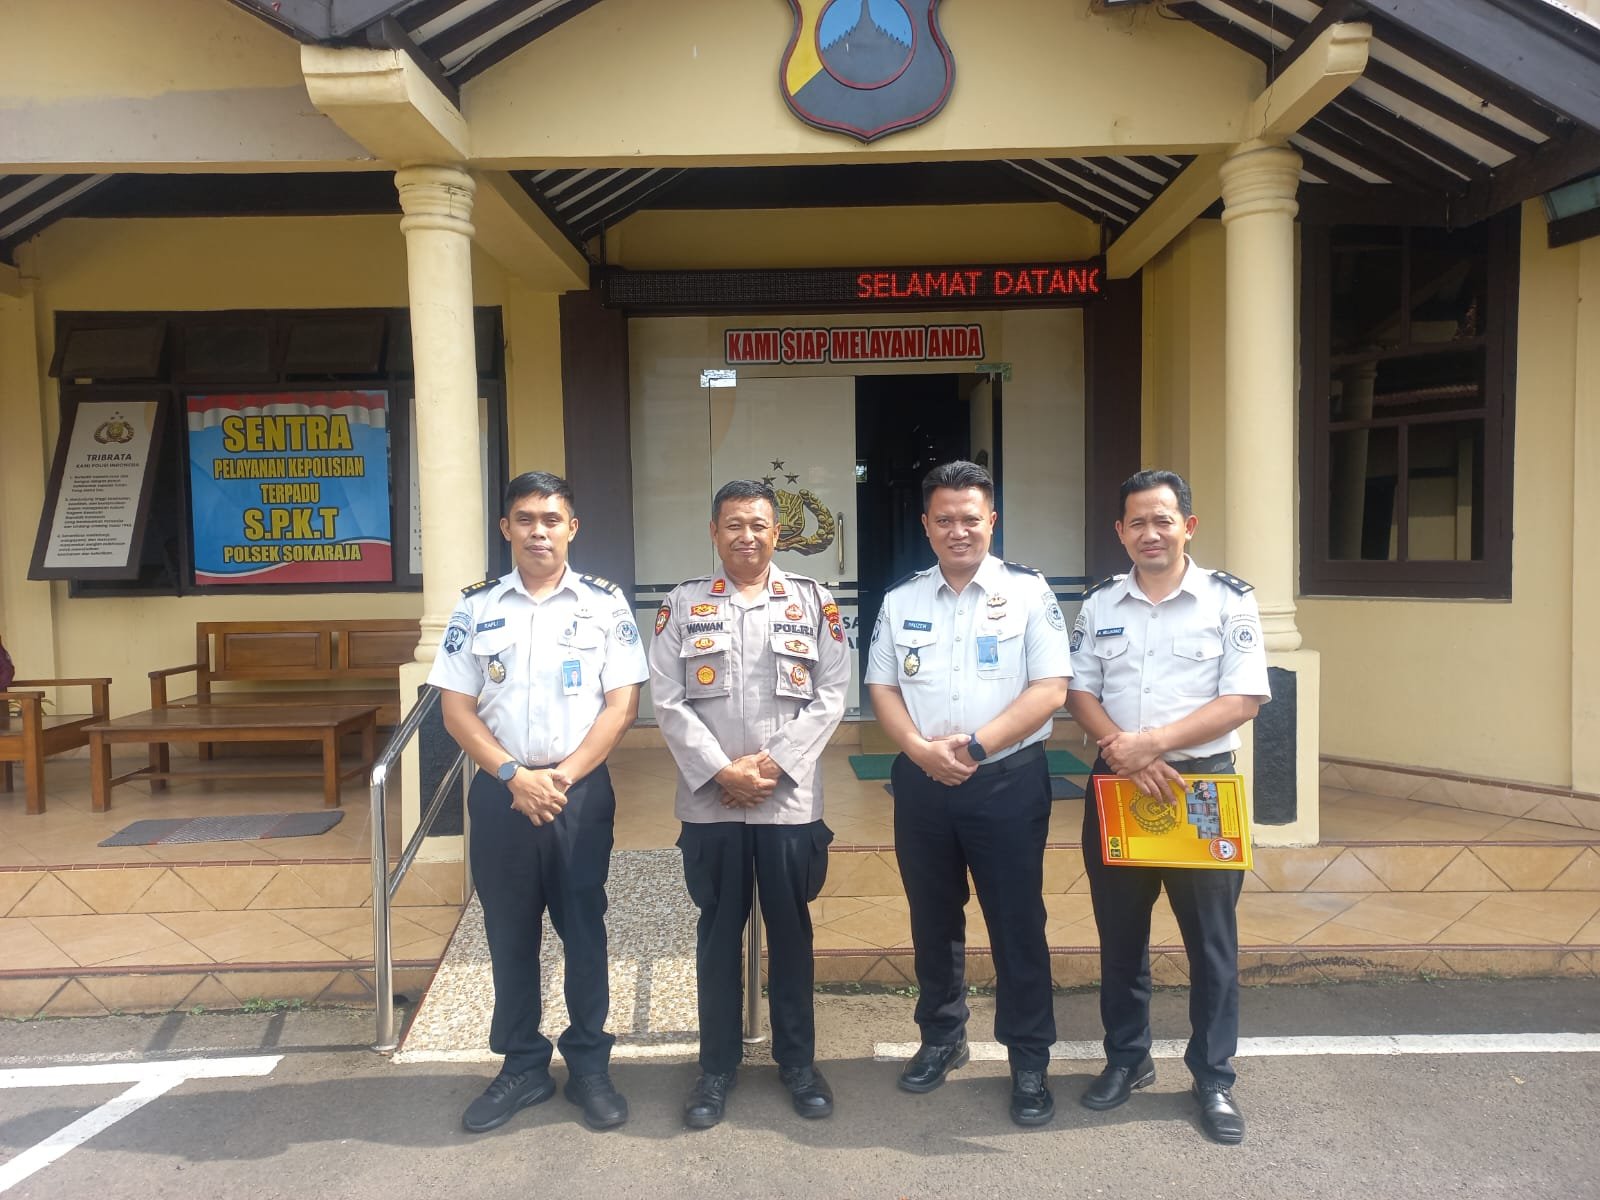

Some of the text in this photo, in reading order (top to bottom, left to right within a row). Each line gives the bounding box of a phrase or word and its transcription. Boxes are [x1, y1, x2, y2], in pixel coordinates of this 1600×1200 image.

[857, 271, 982, 297] SELAMAT
[727, 326, 982, 361] KAMI SIAP MELAYANI ANDA
[222, 414, 353, 452] SENTRA
[214, 456, 364, 480] PELAYANAN KEPOLISIAN
[260, 483, 320, 504] TERPADU
[243, 507, 339, 541] S.P.K.T
[224, 543, 362, 563] POLSEK SOKARAJA
[686, 622, 723, 634] WAWAN
[773, 623, 814, 636] POLRI
